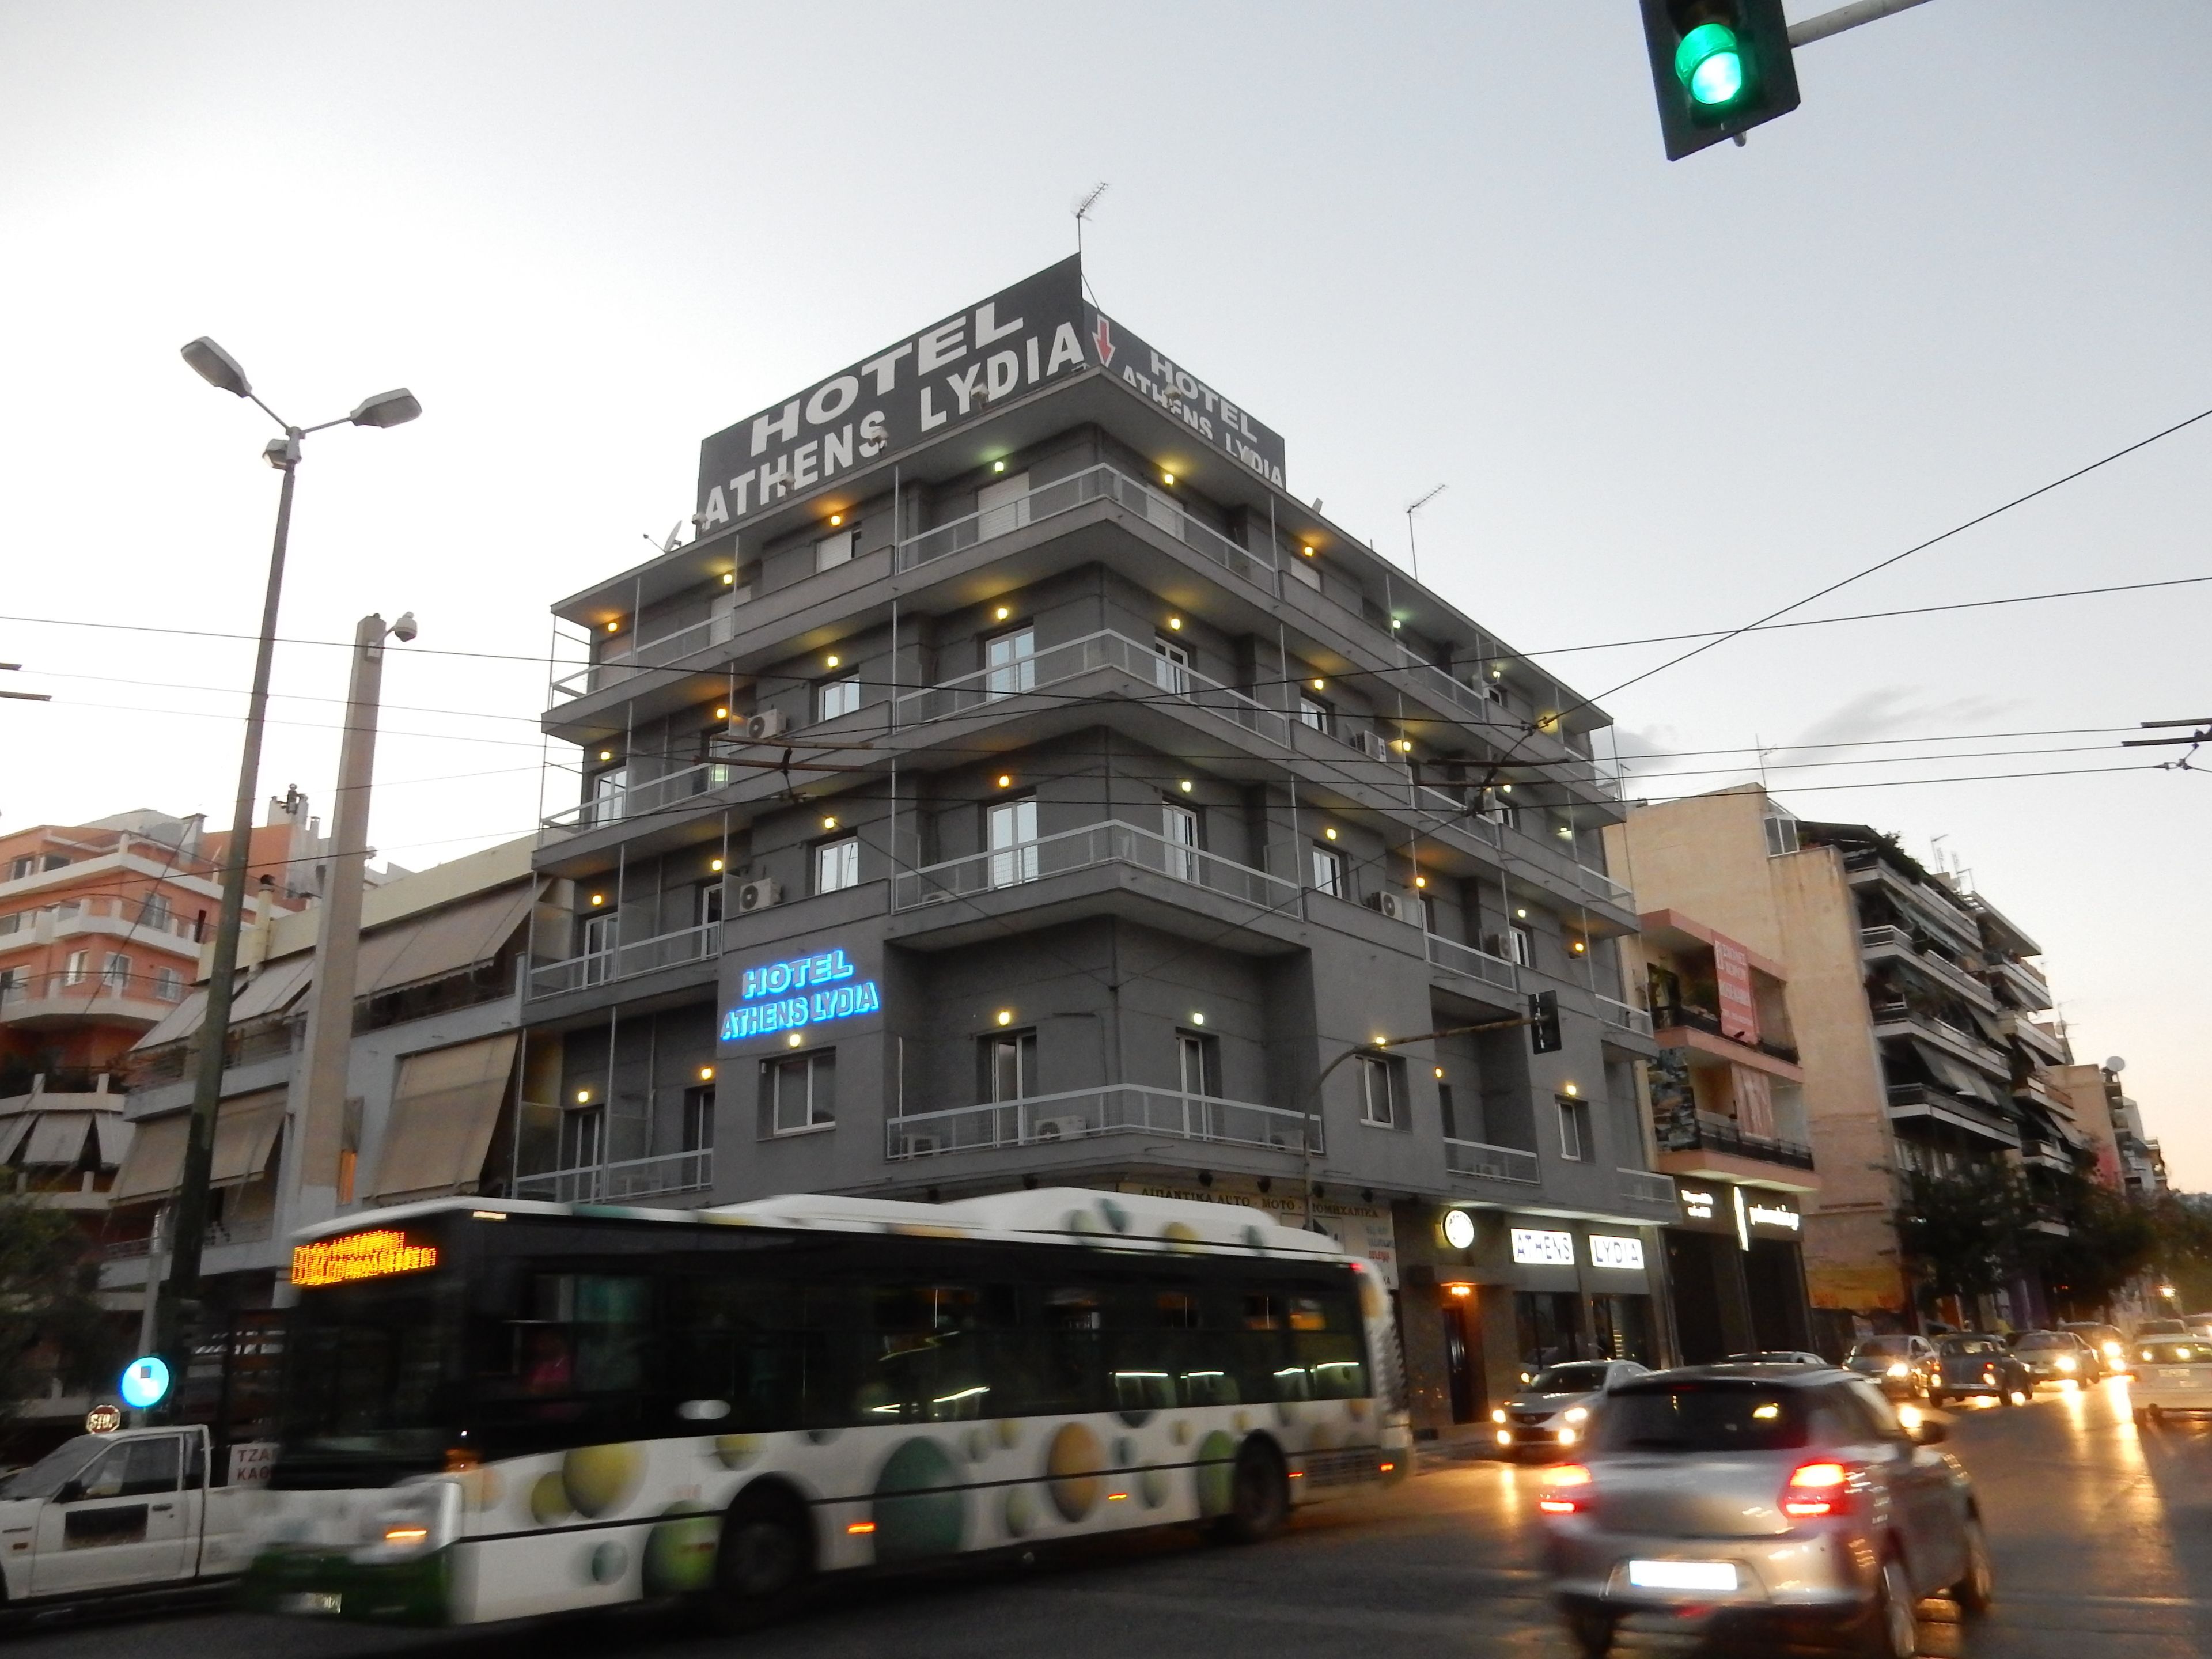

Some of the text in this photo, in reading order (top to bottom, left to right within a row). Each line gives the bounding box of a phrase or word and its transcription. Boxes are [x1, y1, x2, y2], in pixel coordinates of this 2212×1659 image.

[751, 302, 1024, 457] HOTEL
[1150, 349, 1257, 444] HOTEL
[702, 321, 1085, 531] ATHENS LYDIA
[1123, 365, 1284, 488] ATHENS LYDIA
[721, 982, 880, 1041] ATHENS LYDIA
[742, 950, 854, 999] HOTEL
[1516, 1234, 1639, 1263] ATHENS LYDIA
[237, 1448, 274, 1463] ΤΖΑ
